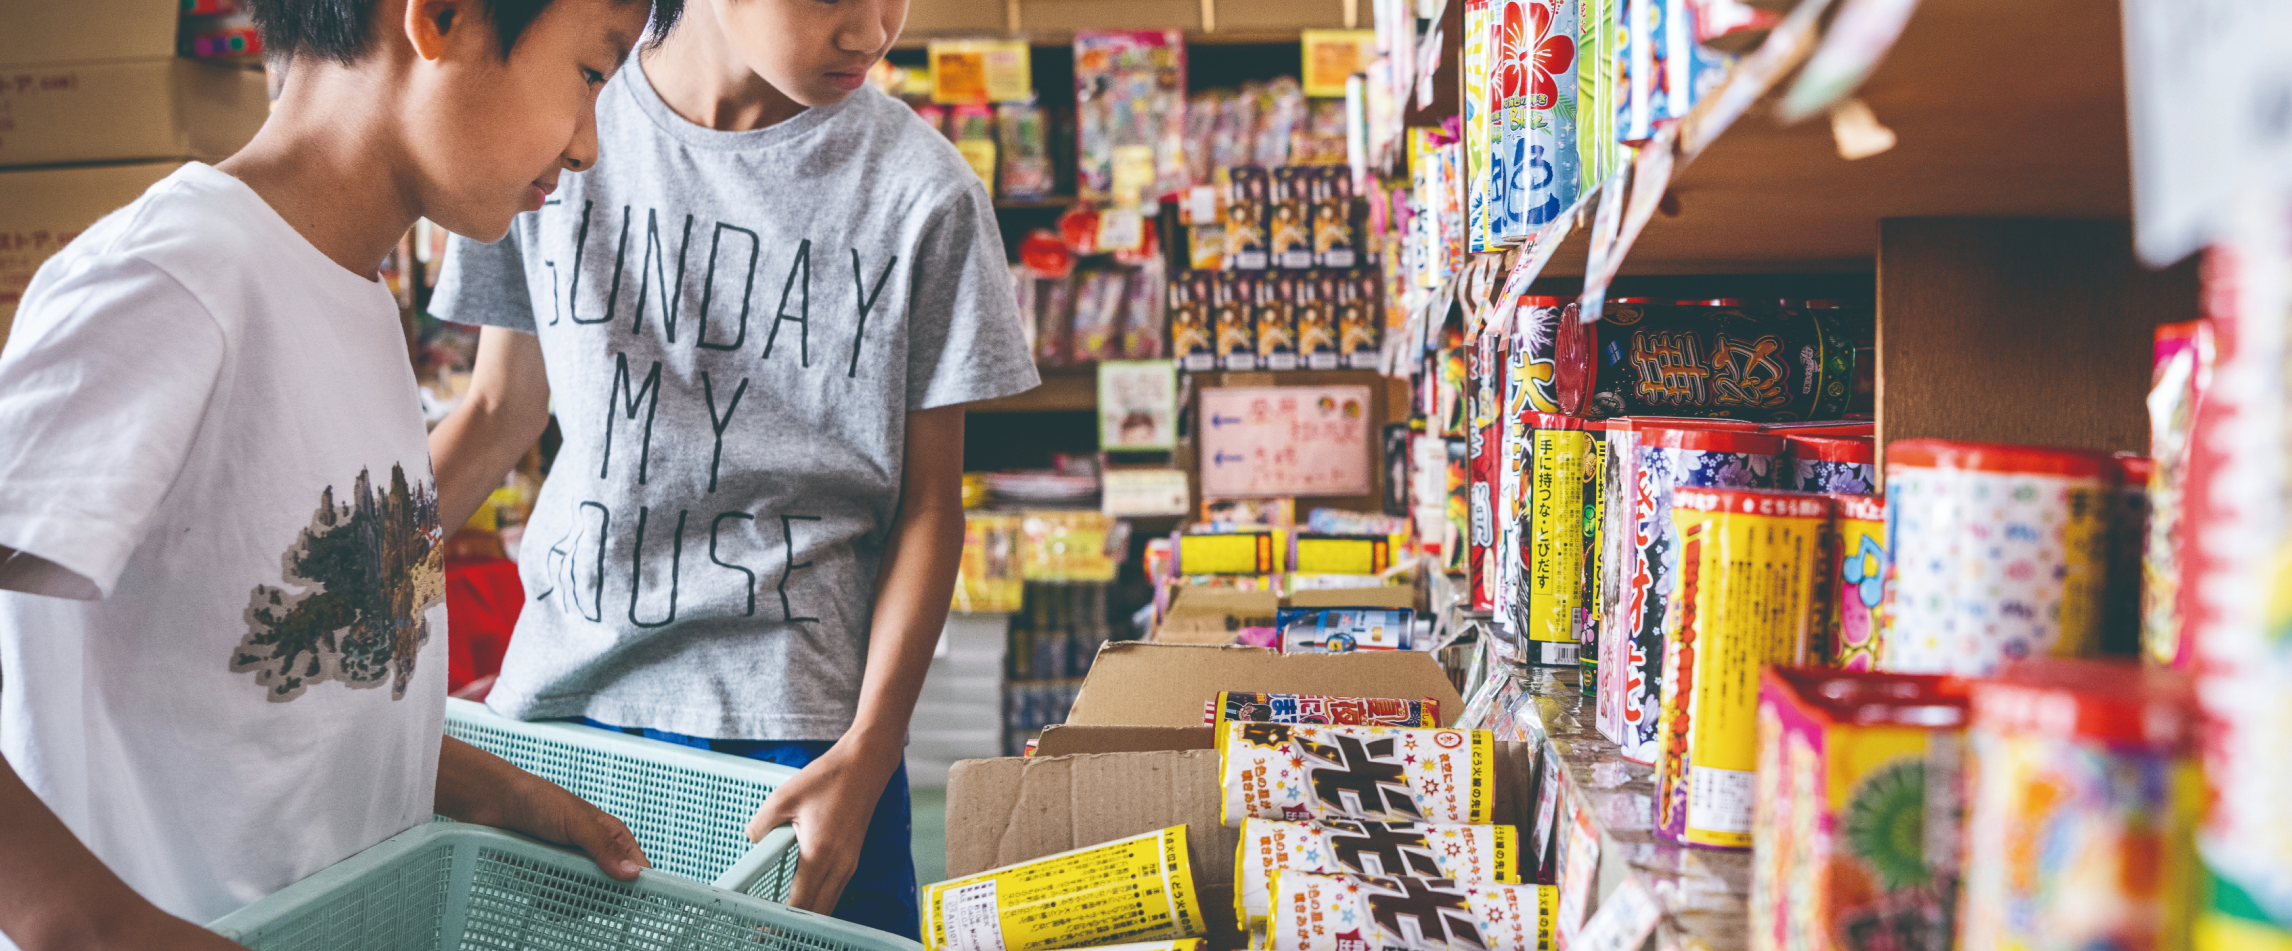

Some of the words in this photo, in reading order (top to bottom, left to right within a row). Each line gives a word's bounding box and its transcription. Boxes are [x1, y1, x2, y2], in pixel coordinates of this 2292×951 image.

[600, 351, 750, 494] MY
[1538, 438, 1553, 590] 手に持つな・とびだす
